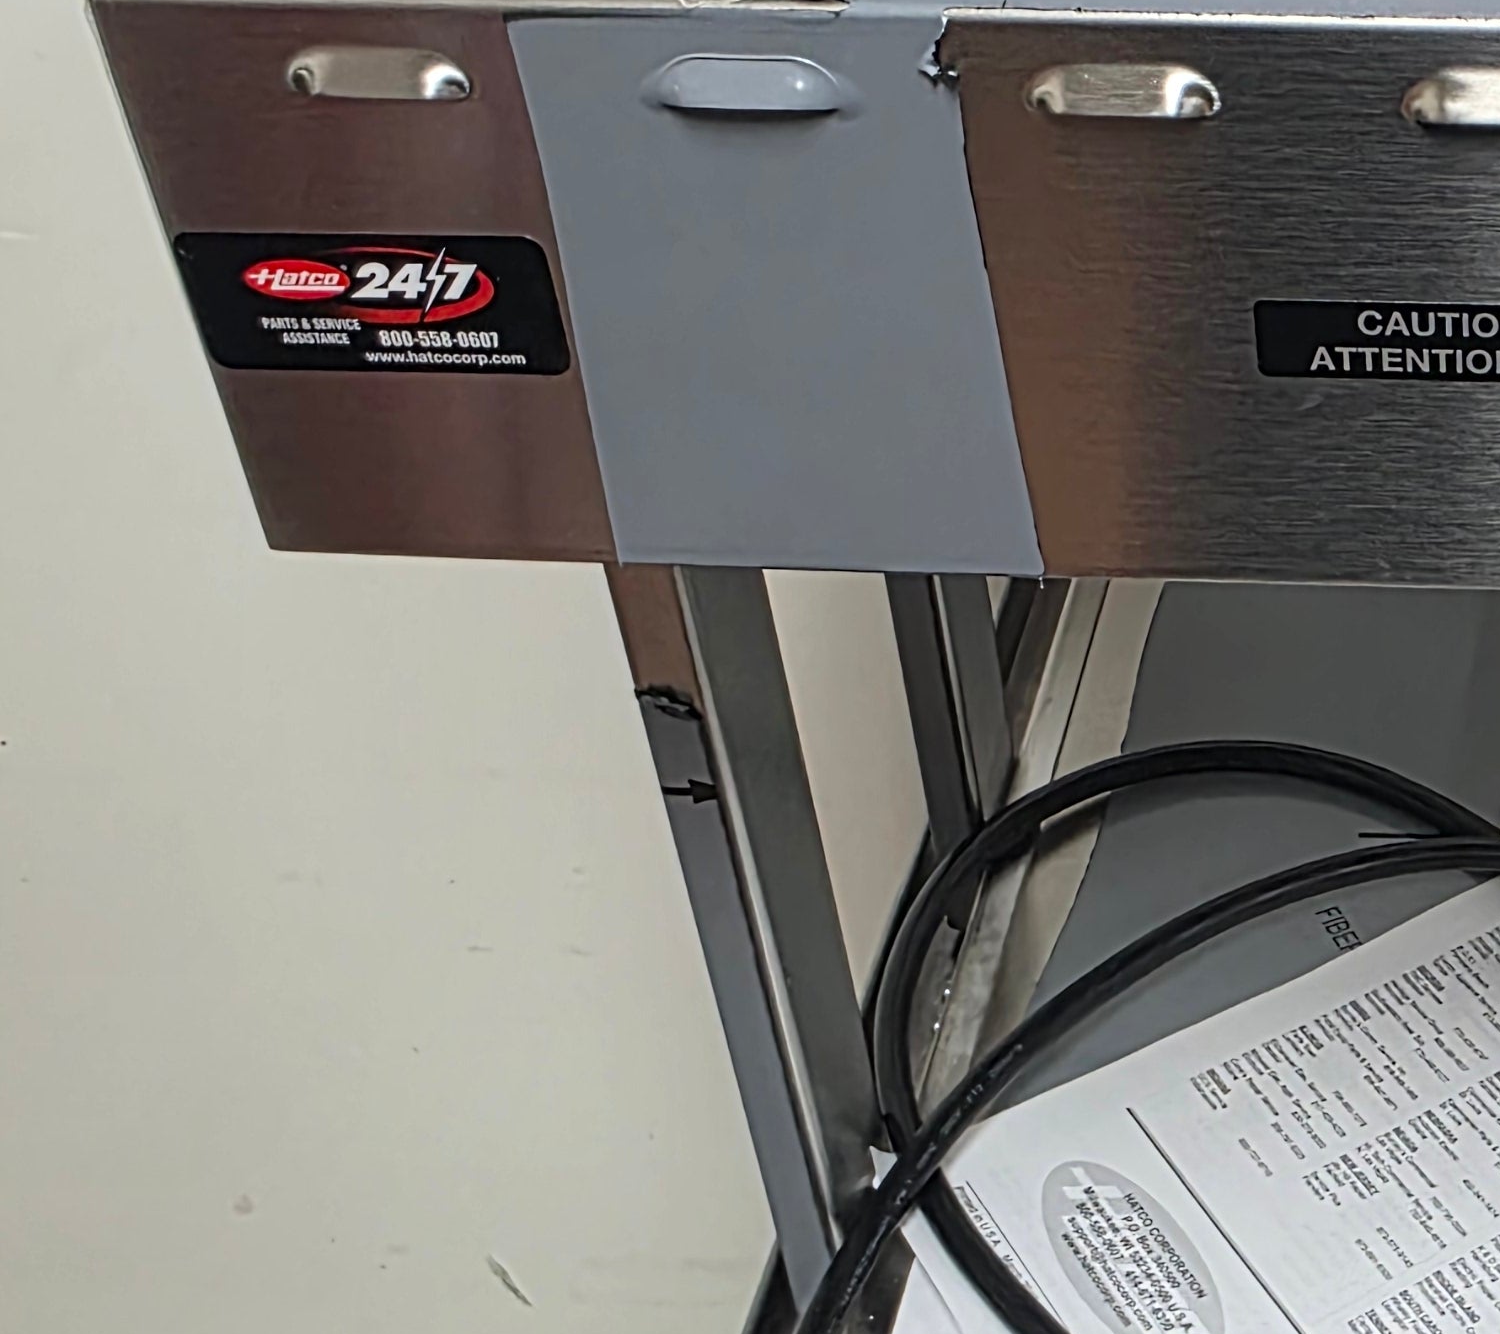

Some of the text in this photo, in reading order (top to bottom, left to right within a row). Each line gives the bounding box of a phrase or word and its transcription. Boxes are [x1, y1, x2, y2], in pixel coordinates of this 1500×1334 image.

[262, 318, 361, 330] PARTS & SERVICE
[283, 331, 499, 348] ASSISTANCE 800-558-0607
[366, 351, 526, 366] www.hatcocorp.com
[1119, 1215, 1143, 1236] P.O.
[1136, 1234, 1156, 1256] Box
[1119, 1236, 1135, 1251] WI
[1121, 1192, 1208, 1299] HATCO CORPORATION
[1067, 1214, 1158, 1331] support@hatcocorp.com
